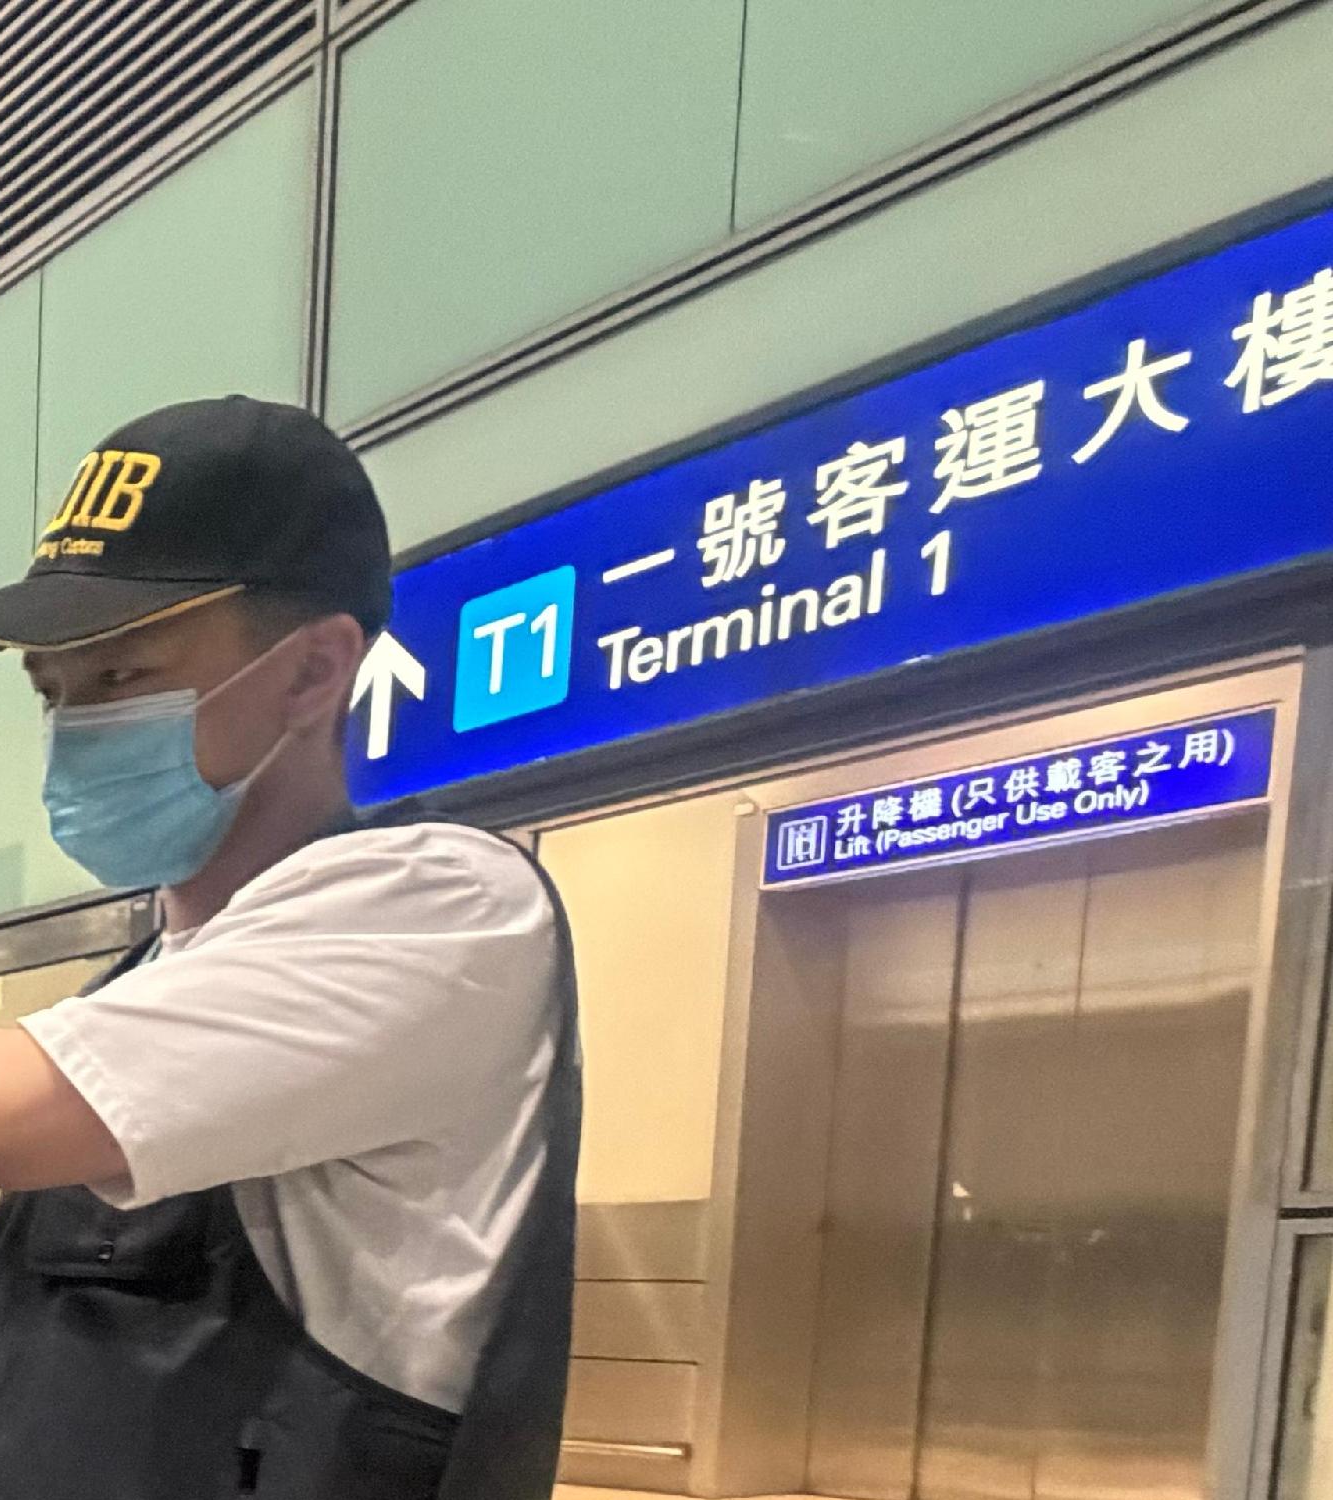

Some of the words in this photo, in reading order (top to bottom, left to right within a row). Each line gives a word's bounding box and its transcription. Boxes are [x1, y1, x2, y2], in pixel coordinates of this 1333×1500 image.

[602, 267, 1333, 588] 一號客運大樓
[473, 604, 560, 694] T1
[597, 548, 886, 690] Terminal
[920, 529, 952, 596] 1
[834, 834, 872, 860] Lift
[875, 812, 1011, 855] (Passenger
[1015, 801, 1069, 825] Use
[1073, 779, 1150, 814] Only)
